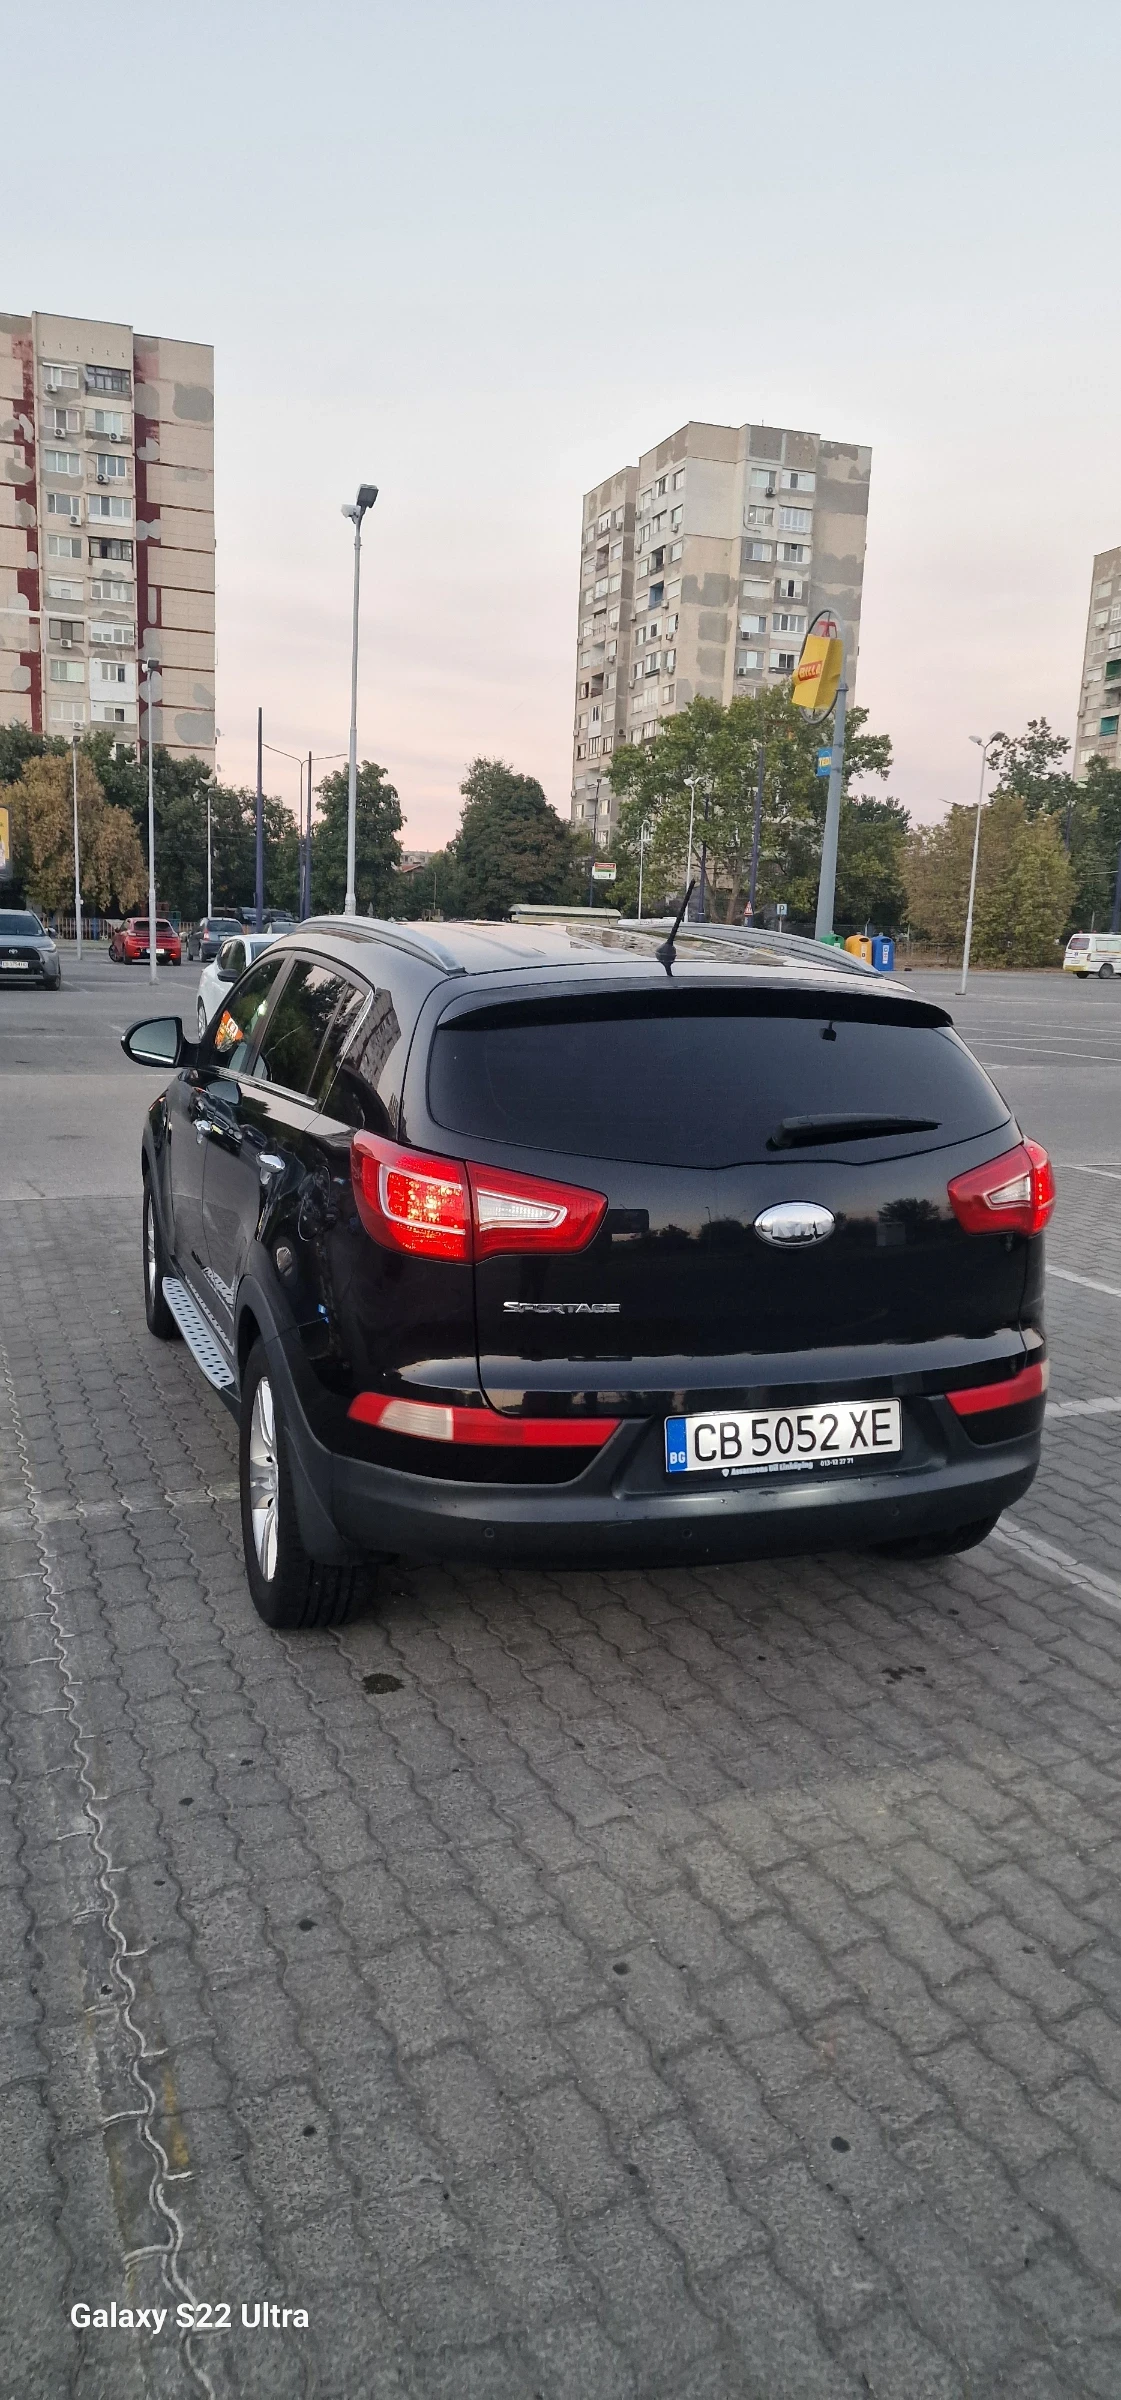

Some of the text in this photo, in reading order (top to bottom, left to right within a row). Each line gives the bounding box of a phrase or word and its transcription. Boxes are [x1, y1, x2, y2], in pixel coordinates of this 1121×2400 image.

[799, 663, 821, 678] BILLA
[503, 1301, 620, 1314] SPORTAGE
[694, 1407, 893, 1461] CB 5052 XE
[669, 1451, 686, 1464] BG
